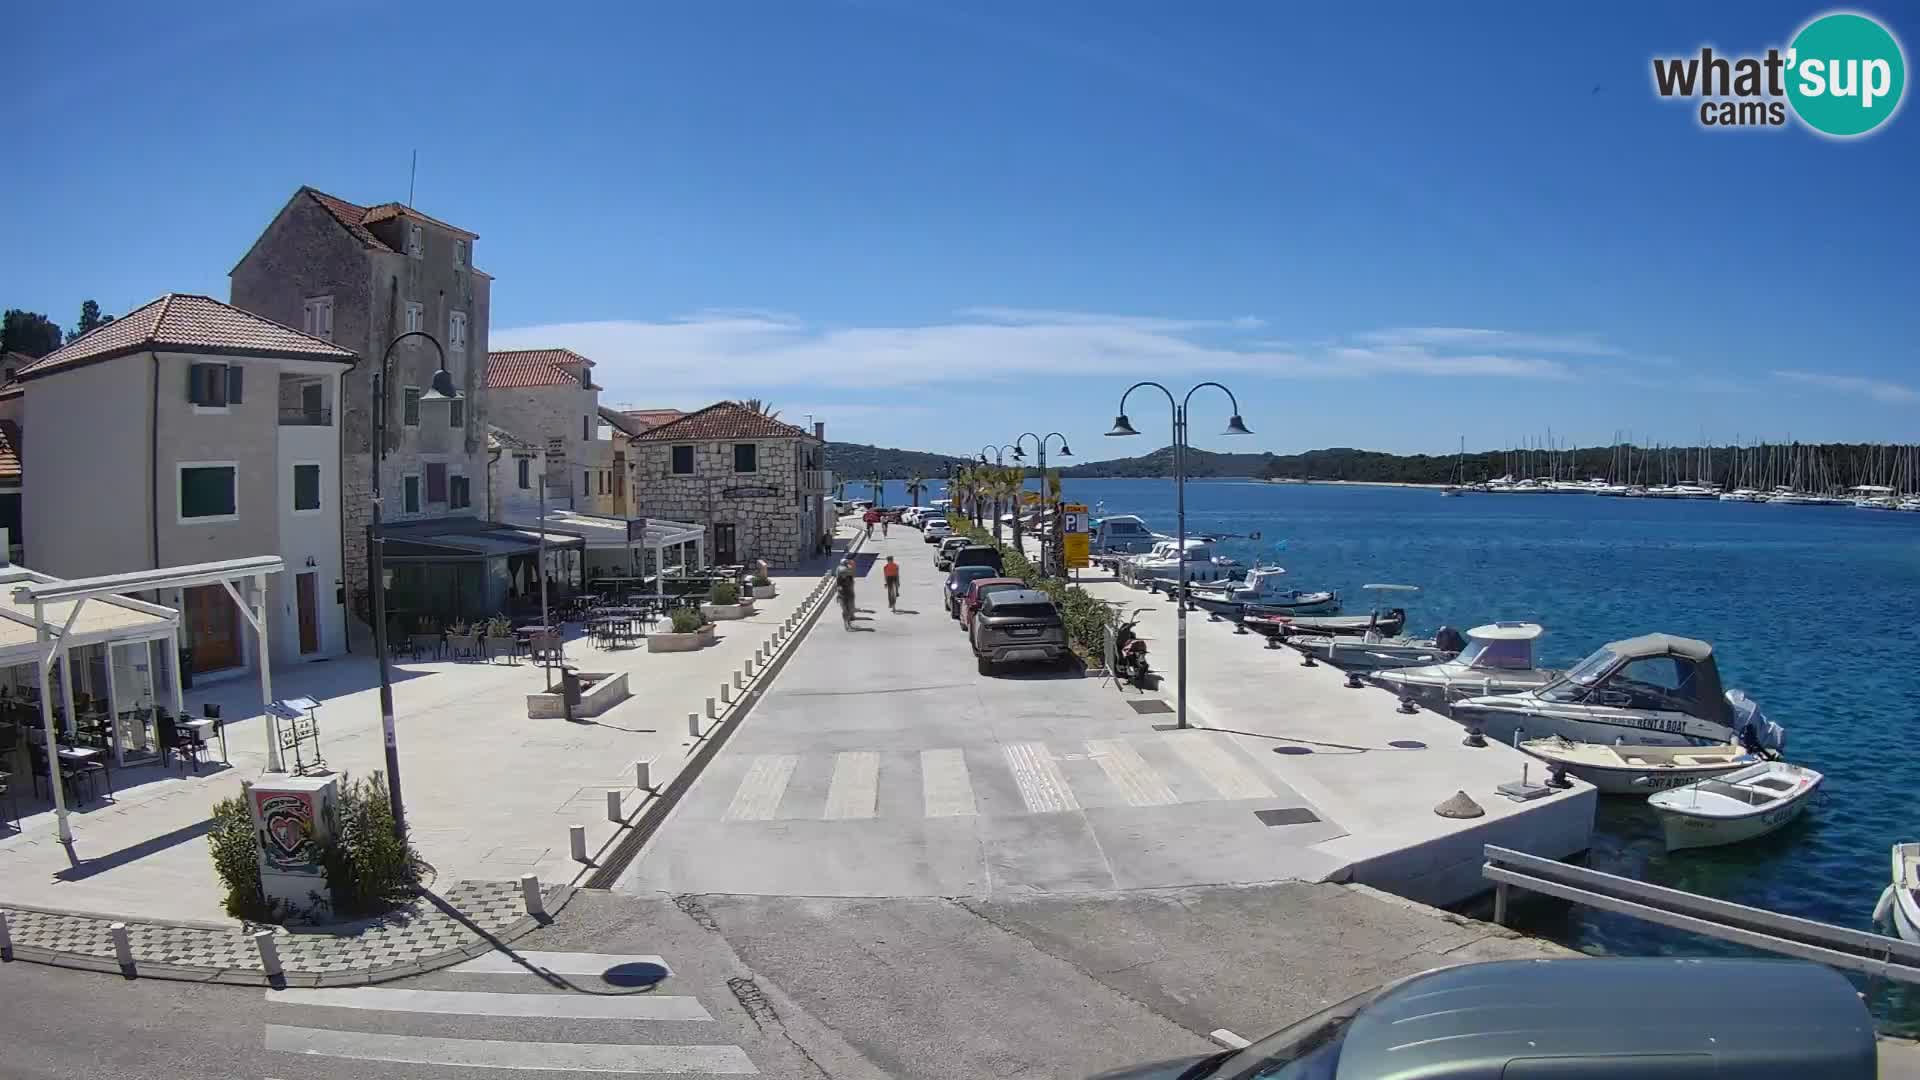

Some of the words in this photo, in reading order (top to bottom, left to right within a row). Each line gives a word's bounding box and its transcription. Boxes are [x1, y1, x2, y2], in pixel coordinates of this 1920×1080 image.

[1065, 514, 1076, 531] P
[1637, 718, 1658, 730] RENT
[1666, 720, 1688, 733] BOAT
